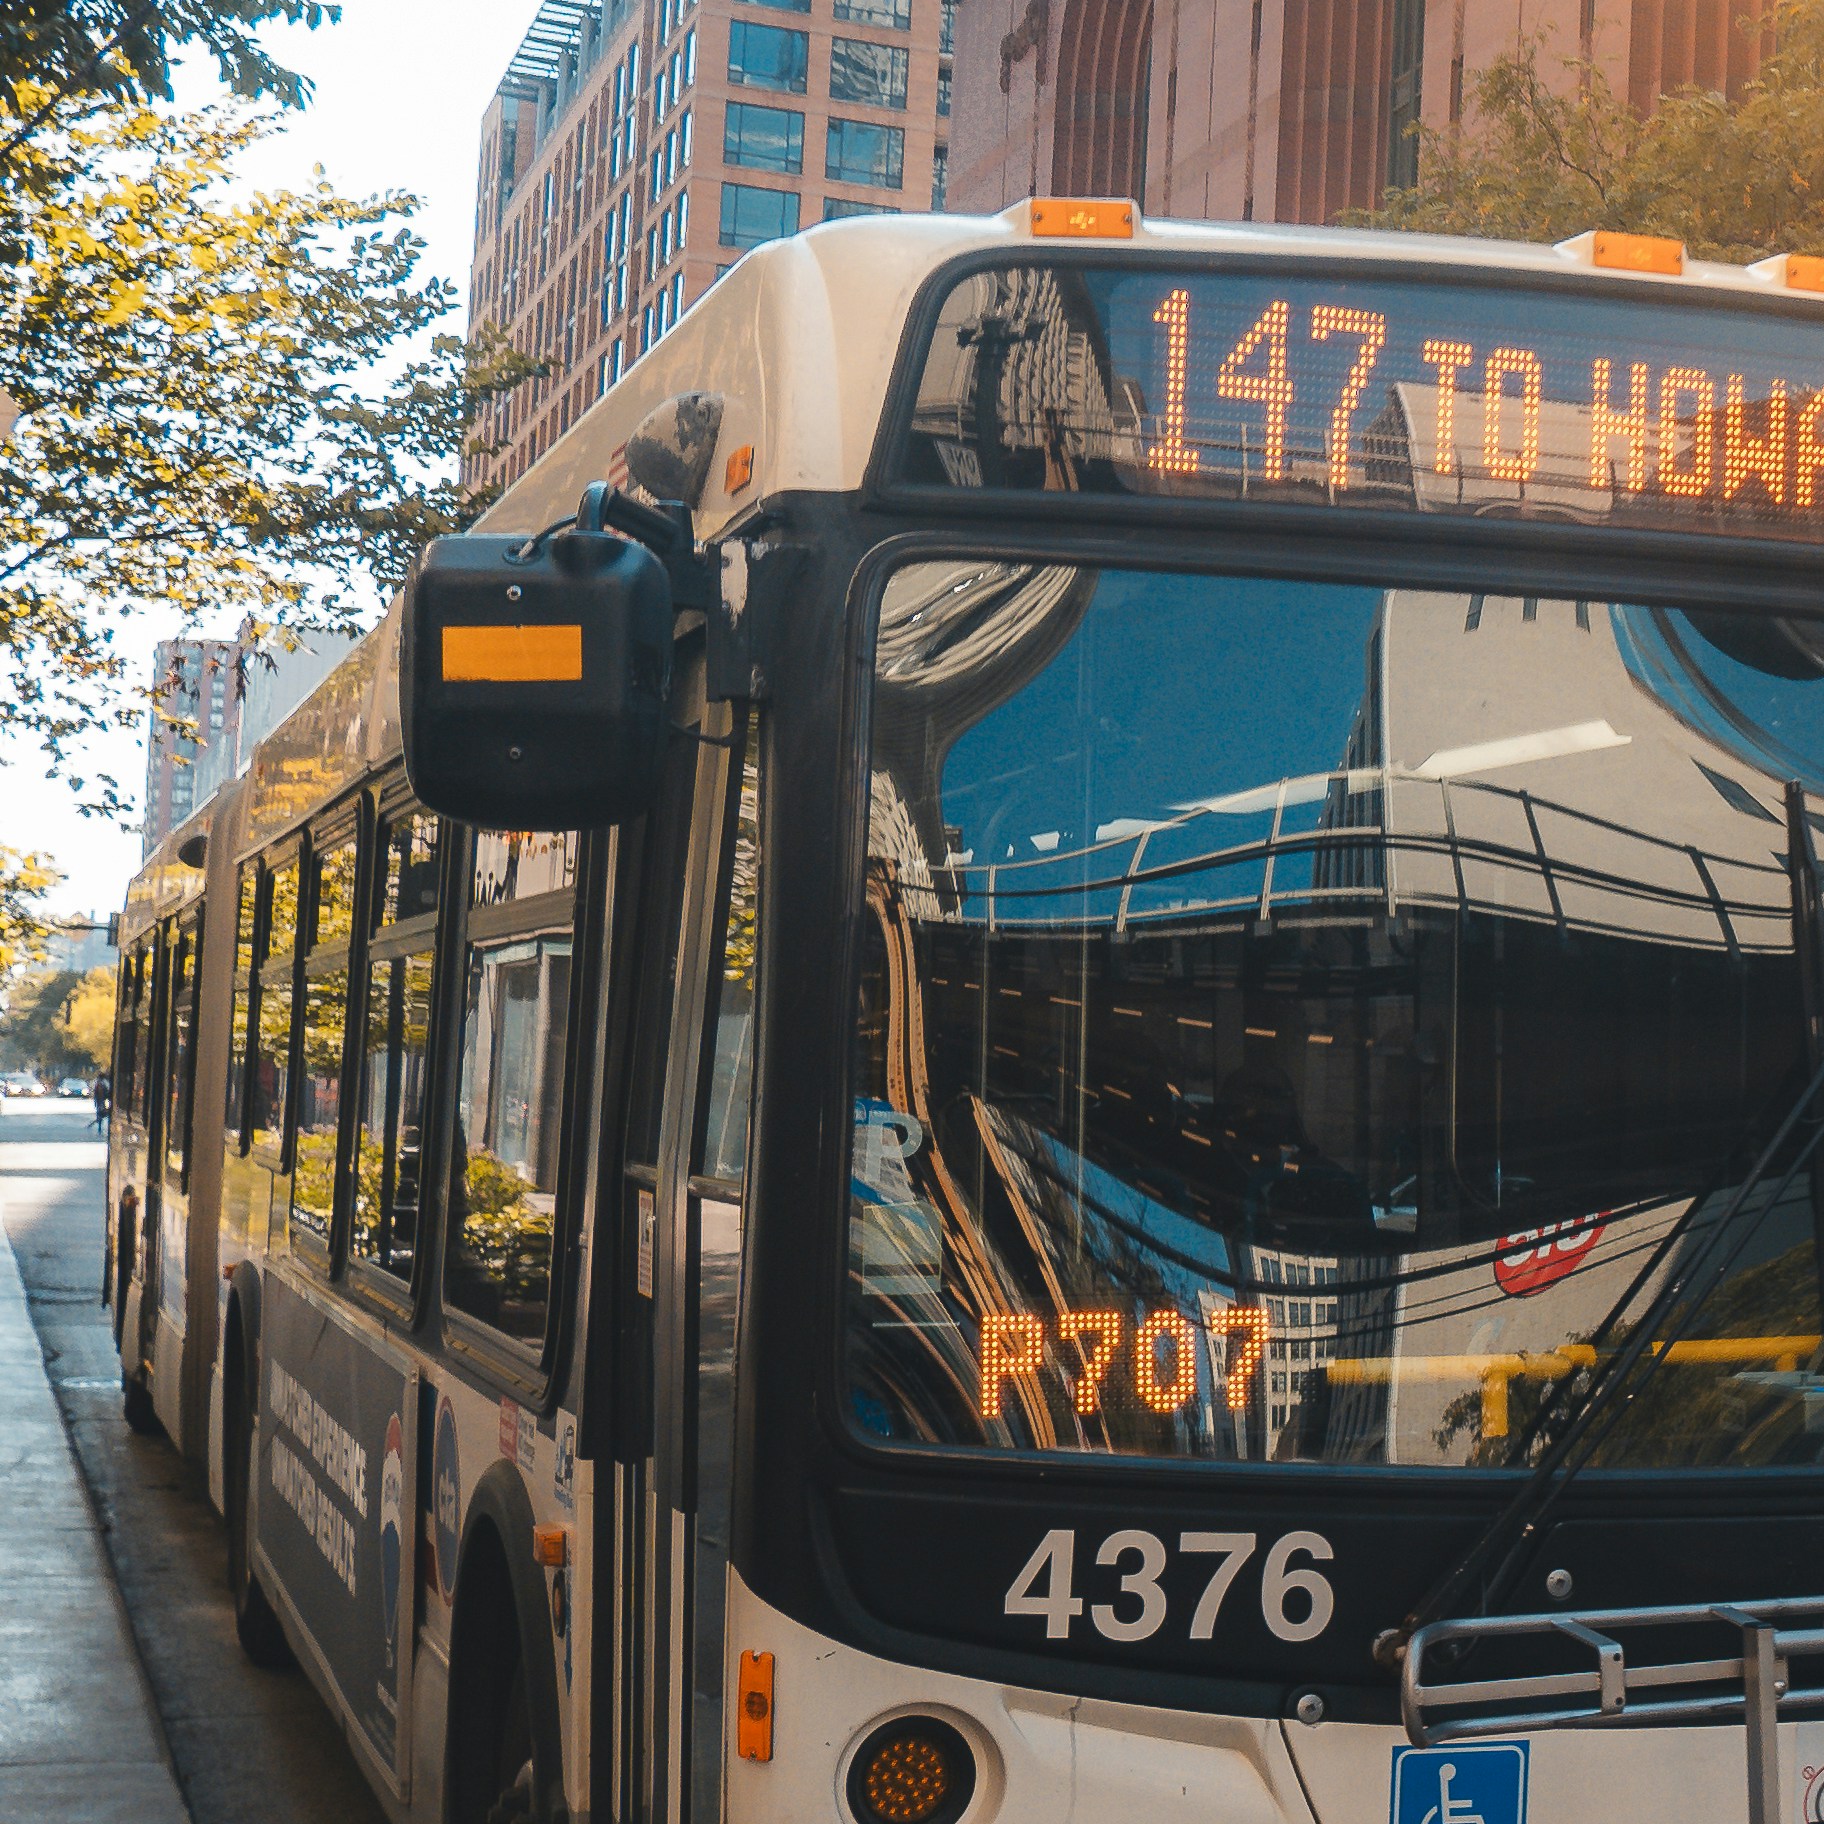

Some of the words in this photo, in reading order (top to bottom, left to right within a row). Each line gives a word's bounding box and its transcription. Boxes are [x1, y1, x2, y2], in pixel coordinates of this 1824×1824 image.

[1146, 288, 1387, 488] 147
[1422, 339, 1543, 481] TO
[979, 1305, 1272, 1417] P707
[1003, 1528, 1335, 1642] 4376
